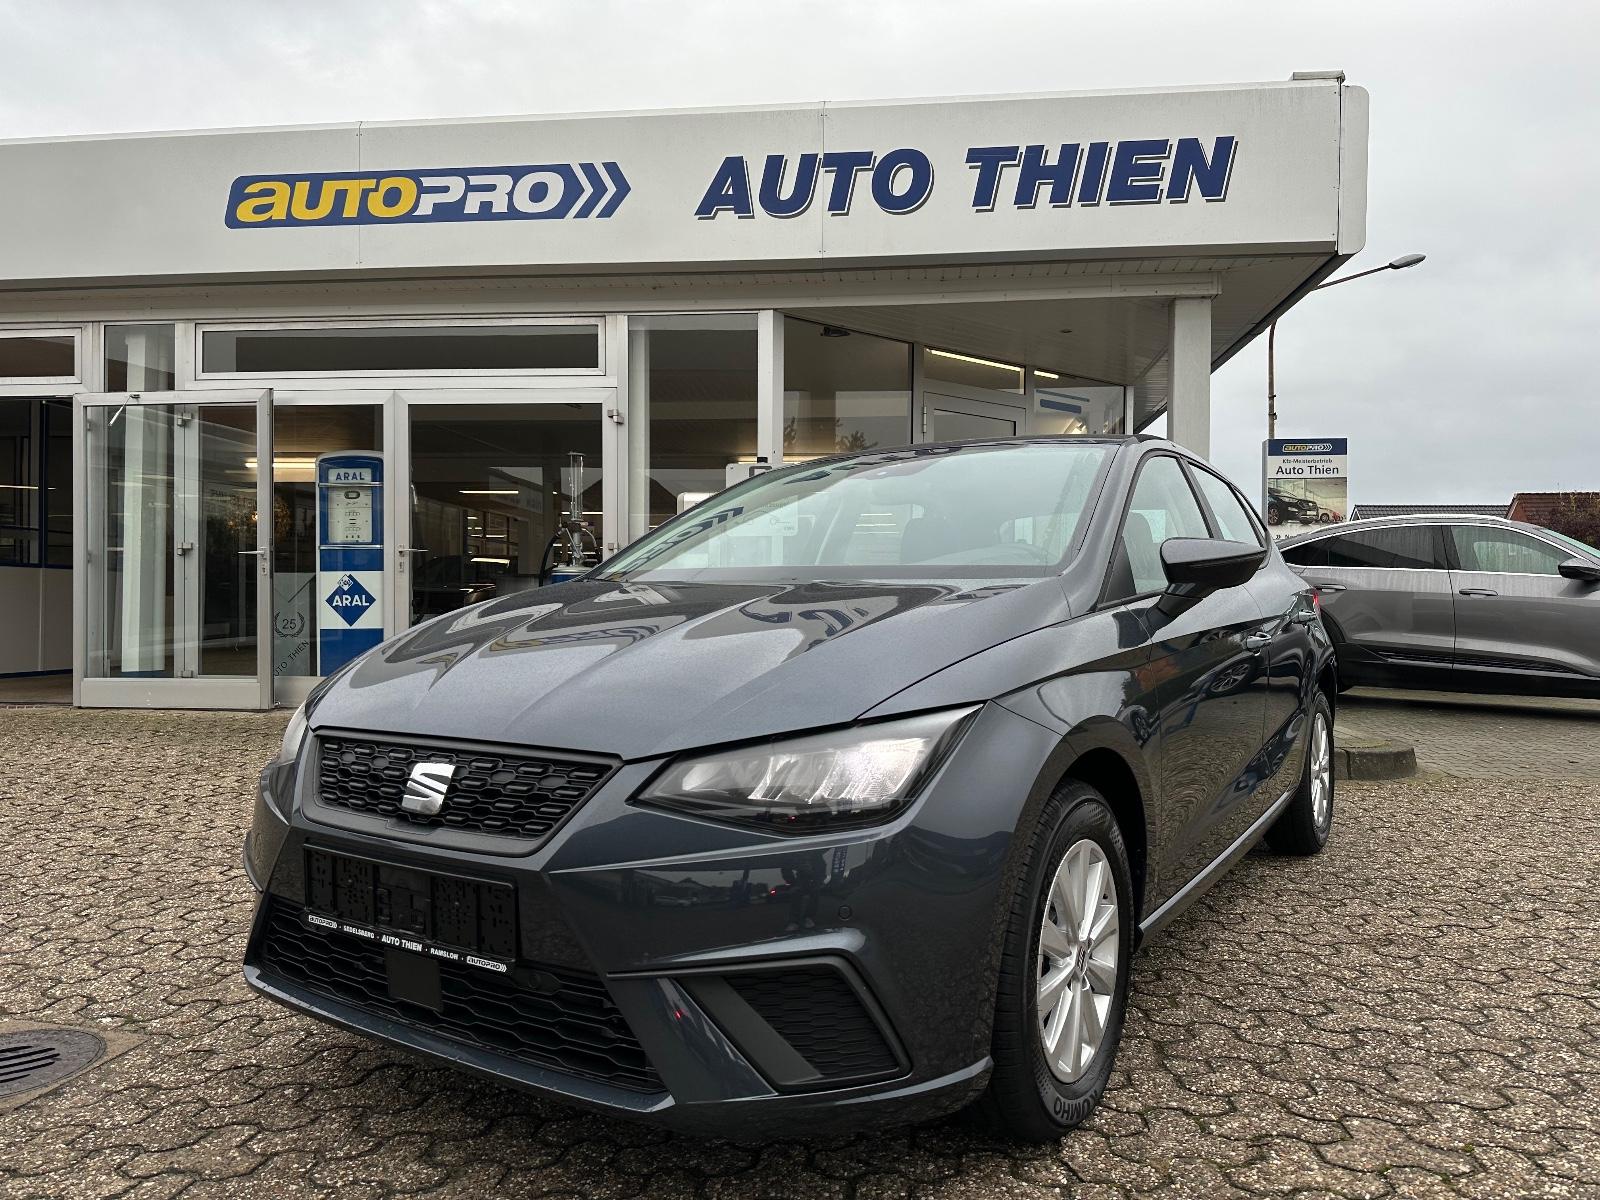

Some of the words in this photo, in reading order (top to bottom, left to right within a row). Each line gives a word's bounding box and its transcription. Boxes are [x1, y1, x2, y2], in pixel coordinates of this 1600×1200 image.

[693, 148, 934, 220] AUTO
[964, 135, 1239, 213] THIEN
[1276, 465, 1304, 475] Auto
[1307, 464, 1339, 475] Thien
[335, 472, 365, 481] ARAL
[332, 595, 369, 607] ARAL
[282, 618, 297, 630] 25
[274, 661, 288, 677] UTO
[288, 640, 310, 661] THIEN
[381, 934, 400, 946] AUTO
[401, 939, 423, 952] THIEN
